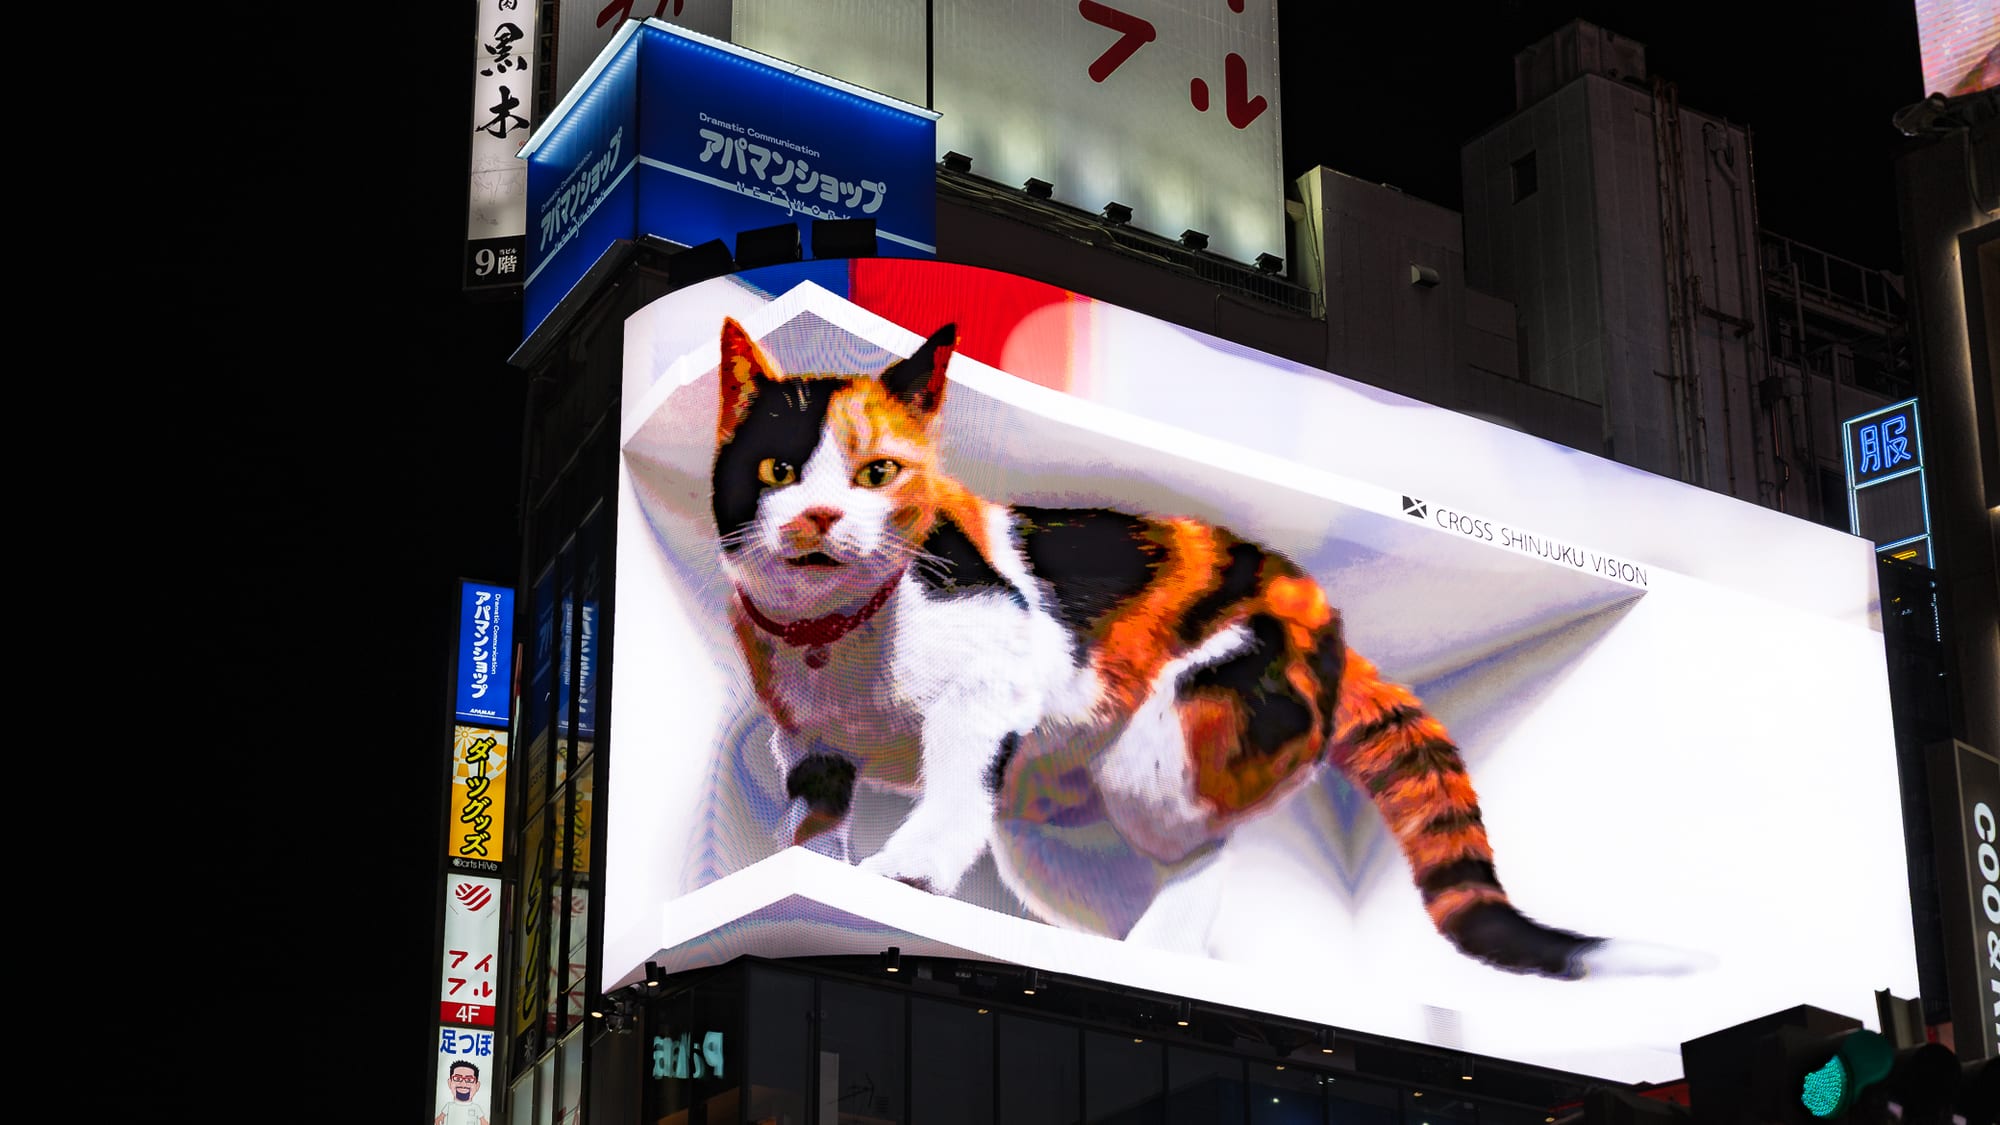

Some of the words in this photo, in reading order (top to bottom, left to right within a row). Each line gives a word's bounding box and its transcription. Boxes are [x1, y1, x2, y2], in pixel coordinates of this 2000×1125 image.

[699, 112, 745, 134] Dramatic
[747, 128, 820, 158] Communication
[540, 126, 623, 252] アパマンショップ
[699, 128, 887, 214] アパマンショップ
[1859, 415, 1912, 473] 服
[1435, 508, 1494, 541] CROSS
[1501, 527, 1584, 567] SHINJUKU
[1591, 553, 1648, 586] VISION
[494, 593, 502, 624] Dramatic
[471, 591, 491, 699] アパマンショップ
[491, 624, 500, 675] Communication
[460, 737, 496, 856] ダーツグッズ
[440, 1029, 493, 1057] 足つぼ
[455, 1005, 481, 1023] 4F
